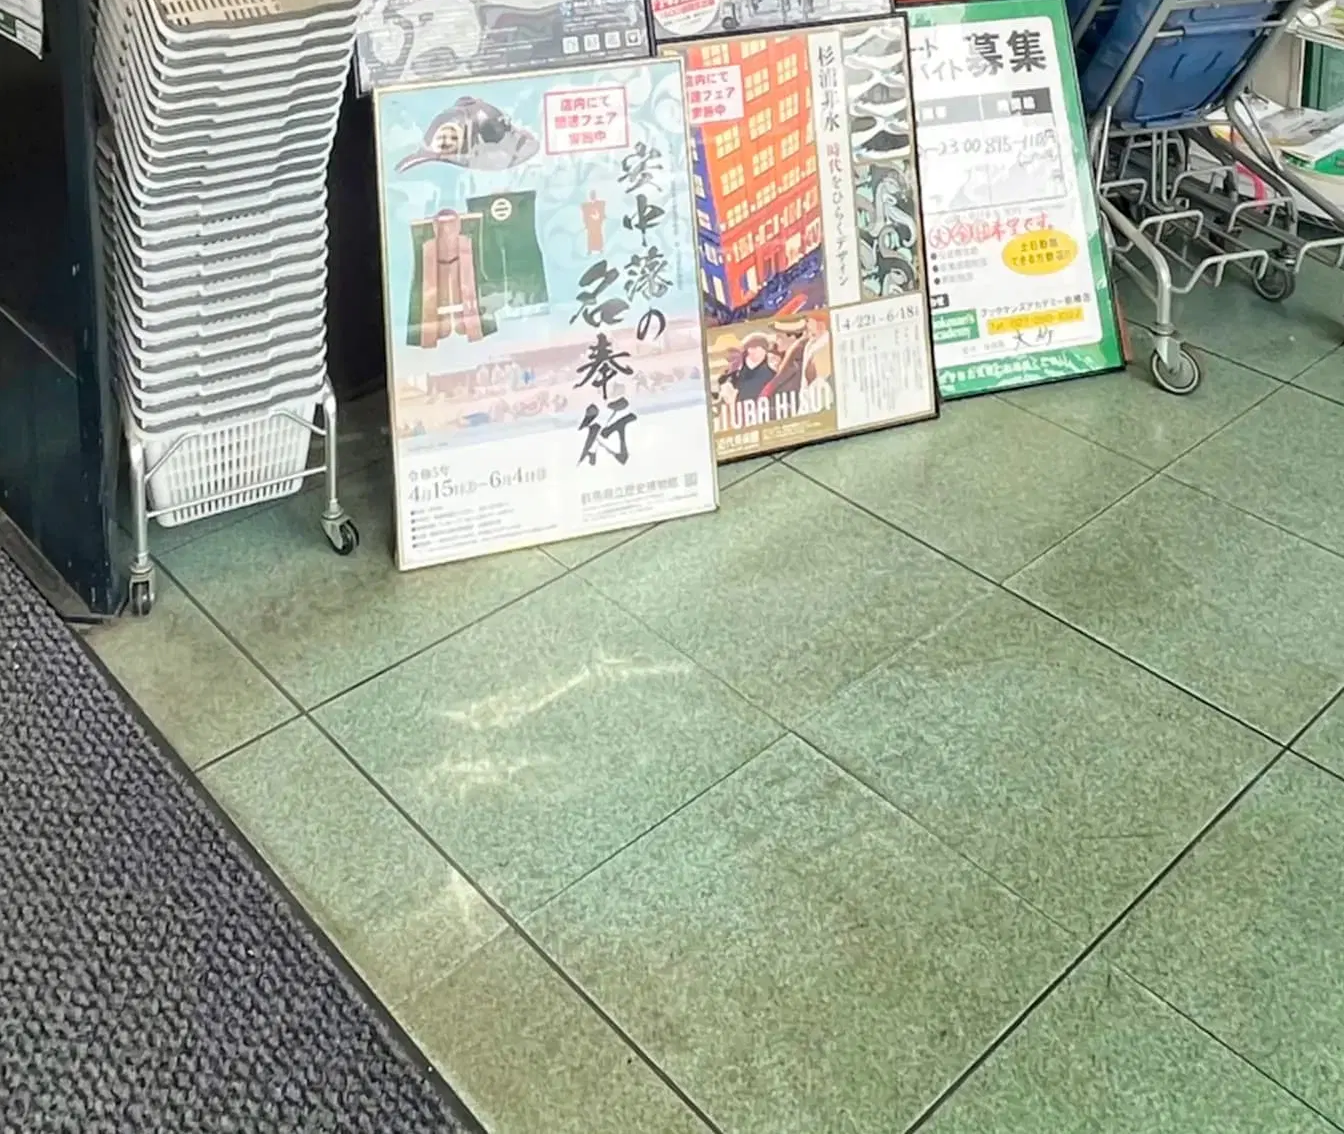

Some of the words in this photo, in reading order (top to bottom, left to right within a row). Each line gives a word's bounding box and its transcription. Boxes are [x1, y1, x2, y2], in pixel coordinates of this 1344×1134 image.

[963, 29, 1048, 77] 募集
[569, 259, 639, 467] 名奉行
